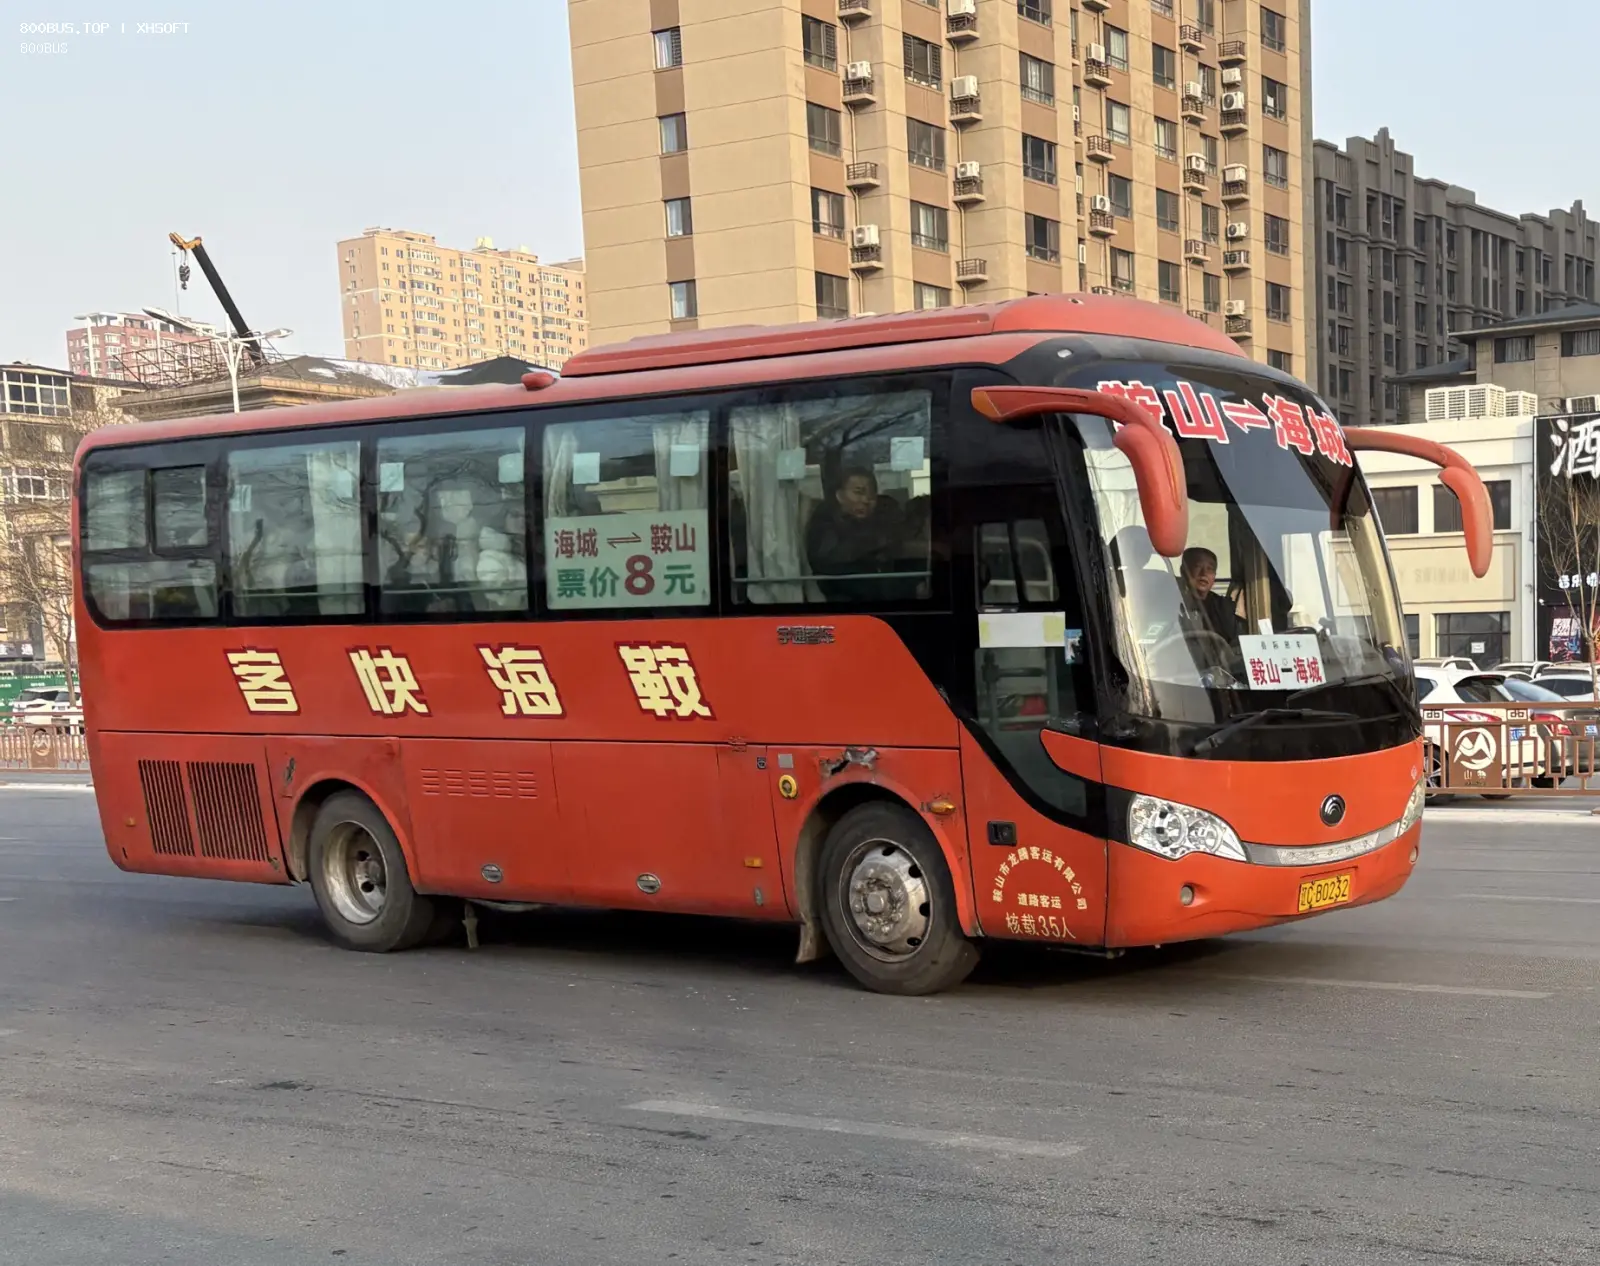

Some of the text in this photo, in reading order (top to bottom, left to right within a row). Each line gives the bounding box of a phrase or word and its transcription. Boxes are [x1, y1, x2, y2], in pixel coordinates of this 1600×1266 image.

[1262, 392, 1353, 467] 海城
[554, 522, 697, 558] 海城 鞍山
